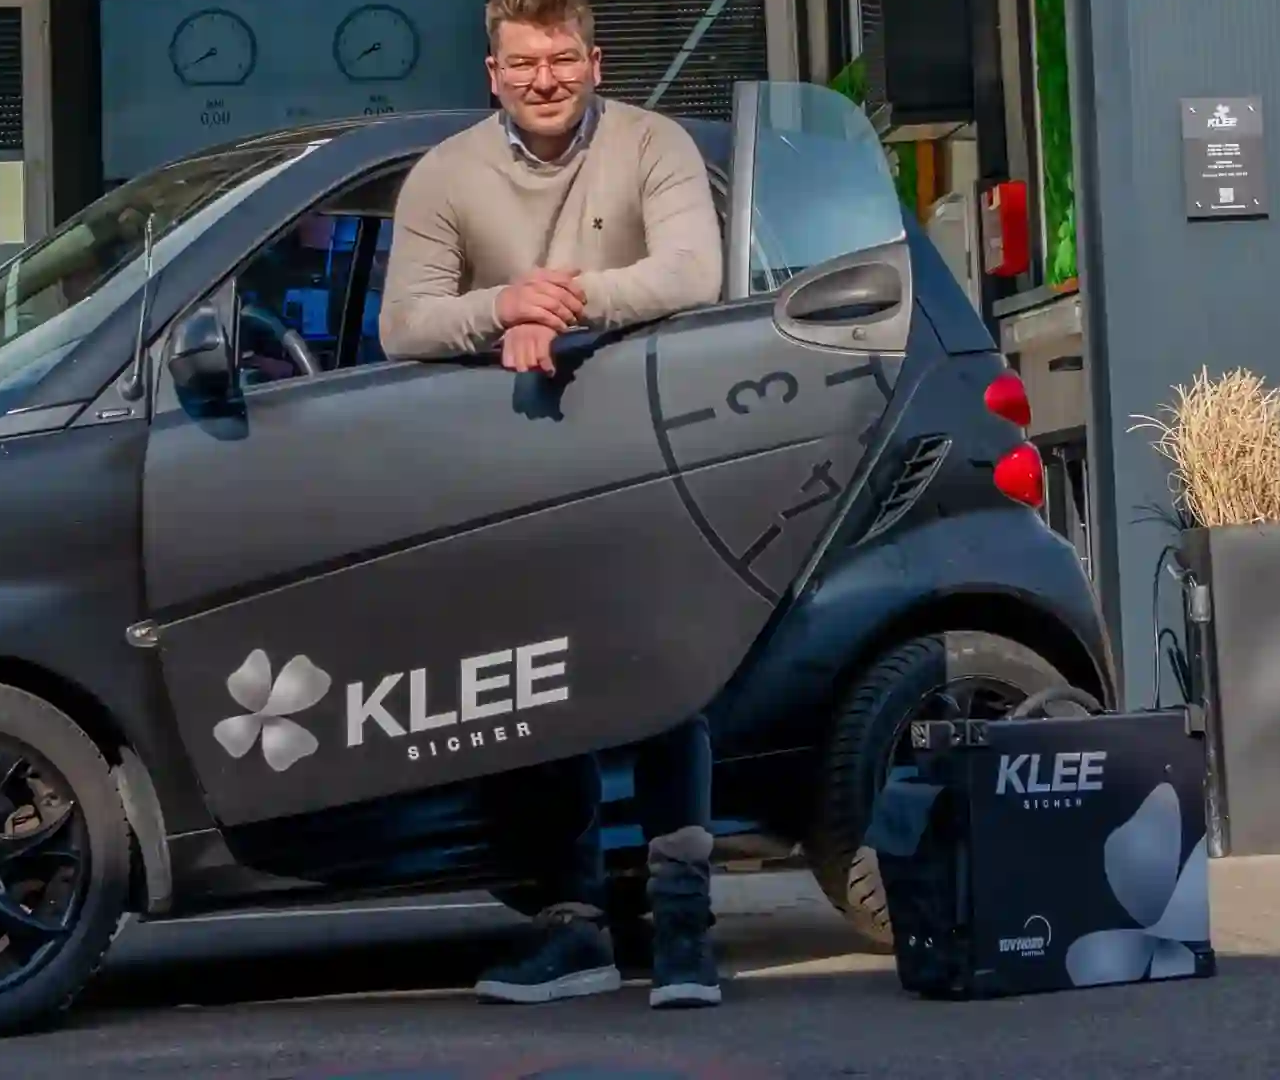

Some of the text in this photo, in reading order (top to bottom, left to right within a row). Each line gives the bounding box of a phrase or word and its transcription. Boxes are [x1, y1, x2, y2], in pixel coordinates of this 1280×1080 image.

[726, 371, 799, 415] 3
[346, 636, 569, 747] KLEE
[407, 721, 532, 761] SICHER
[996, 751, 1107, 794] KLEE
